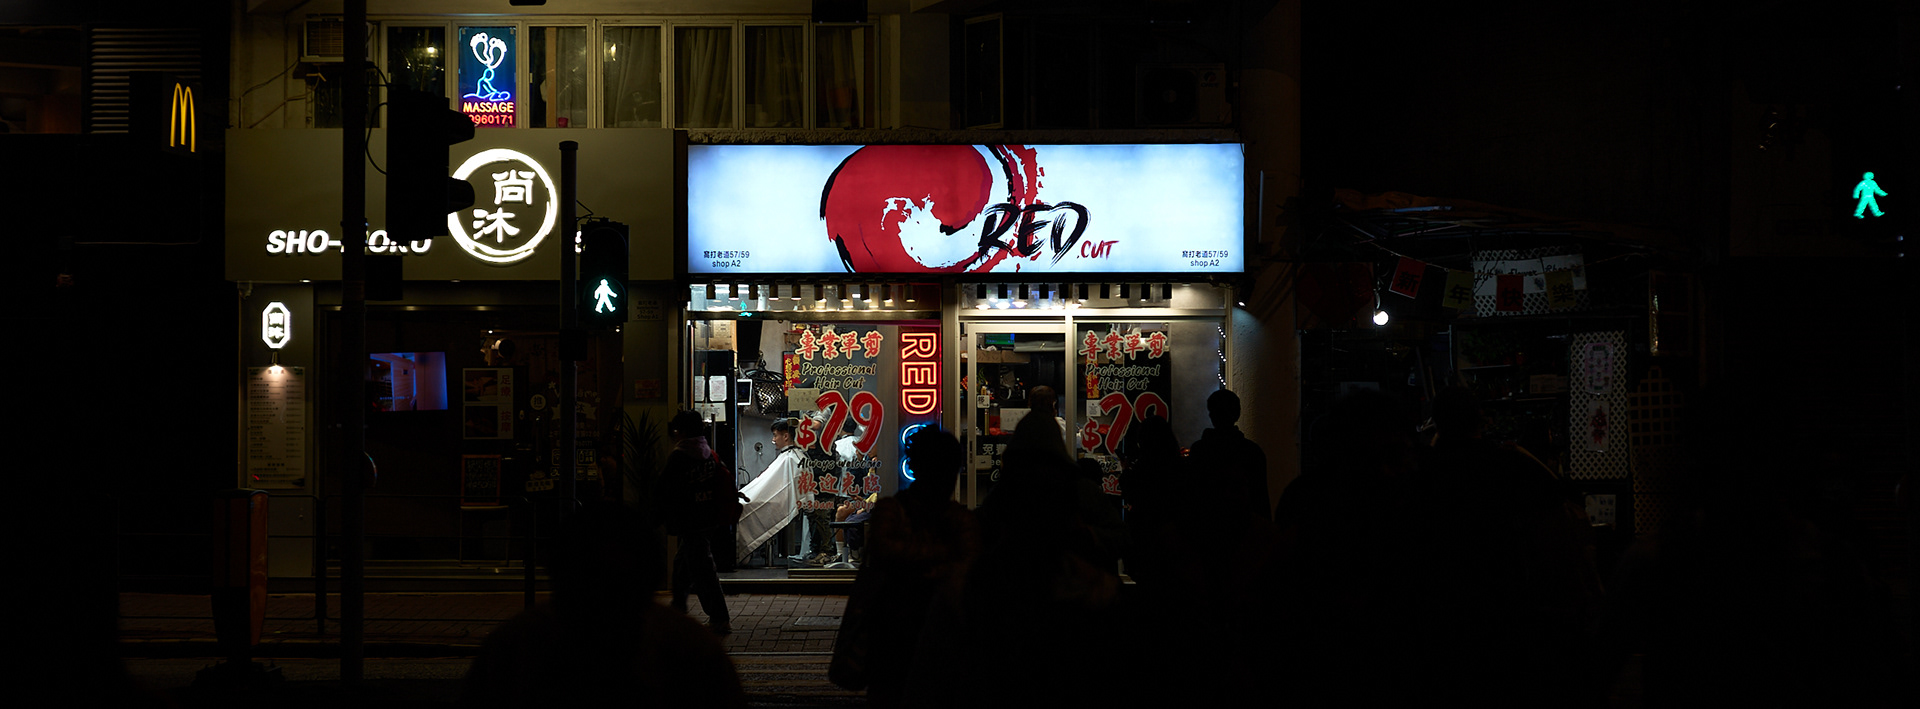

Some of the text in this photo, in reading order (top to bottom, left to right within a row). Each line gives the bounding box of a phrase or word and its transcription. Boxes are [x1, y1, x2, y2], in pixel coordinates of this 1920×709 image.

[462, 102, 514, 113] MASSAGE
[469, 114, 513, 125] 960171
[473, 169, 536, 243] 尚沐
[978, 200, 1092, 267] RED
[712, 259, 741, 269] shop A2
[1190, 258, 1220, 268] shop A2
[796, 330, 883, 360] 專業單剪
[1079, 330, 1168, 361] 專業單剪
[801, 362, 876, 376] Professional
[901, 332, 937, 416] RED
[1085, 363, 1161, 377] Professional
[814, 377, 866, 389] Hair Cut
[1098, 377, 1150, 390] Hair Cut
[794, 390, 885, 456] $79
[797, 457, 883, 471] Always welcome
[797, 471, 882, 495] 歡迎光臨
[844, 500, 876, 513] 9:00p
